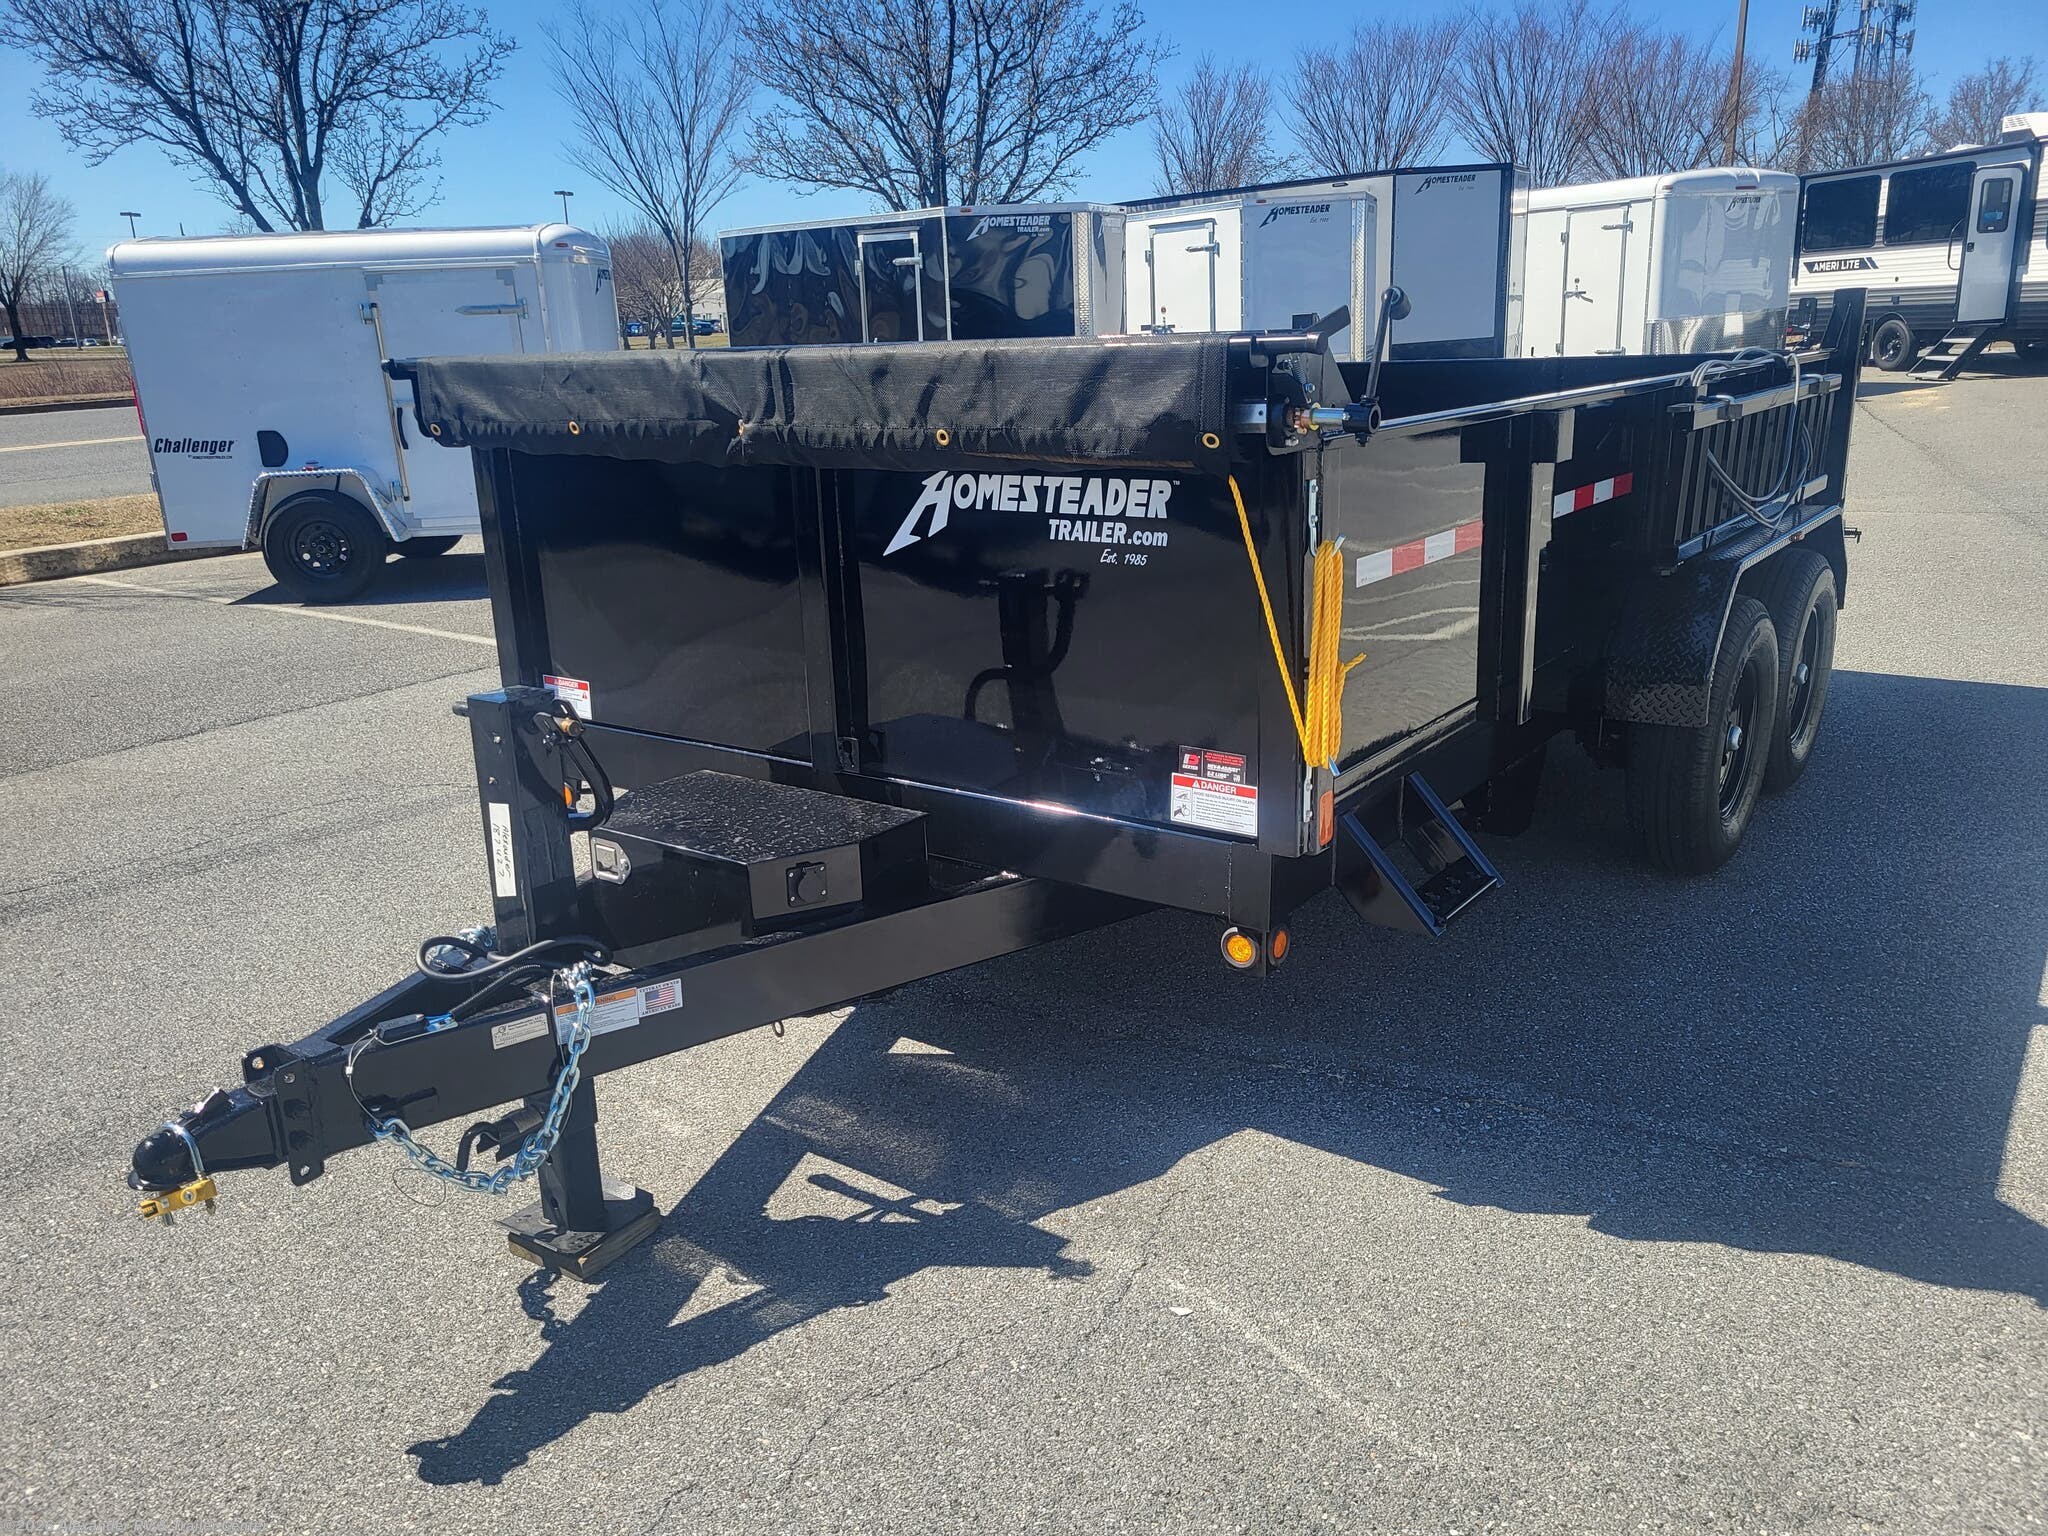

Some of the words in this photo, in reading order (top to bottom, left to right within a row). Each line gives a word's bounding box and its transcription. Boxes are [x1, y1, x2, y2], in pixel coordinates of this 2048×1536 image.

[1415, 175, 1476, 195] HOMESTEADER
[1259, 204, 1331, 228] HOMESTEADER
[966, 215, 1050, 241] HOMESTEADER
[1812, 261, 1840, 272] AMERI
[1841, 259, 1860, 270] LITE
[154, 438, 235, 455] Challenger
[883, 470, 1172, 556] HOMESTEADER
[1049, 519, 1169, 546] TRAILER.com
[1100, 548, 1118, 565] Est.
[1124, 553, 1148, 566] 1985
[1201, 781, 1237, 794] DANGER
